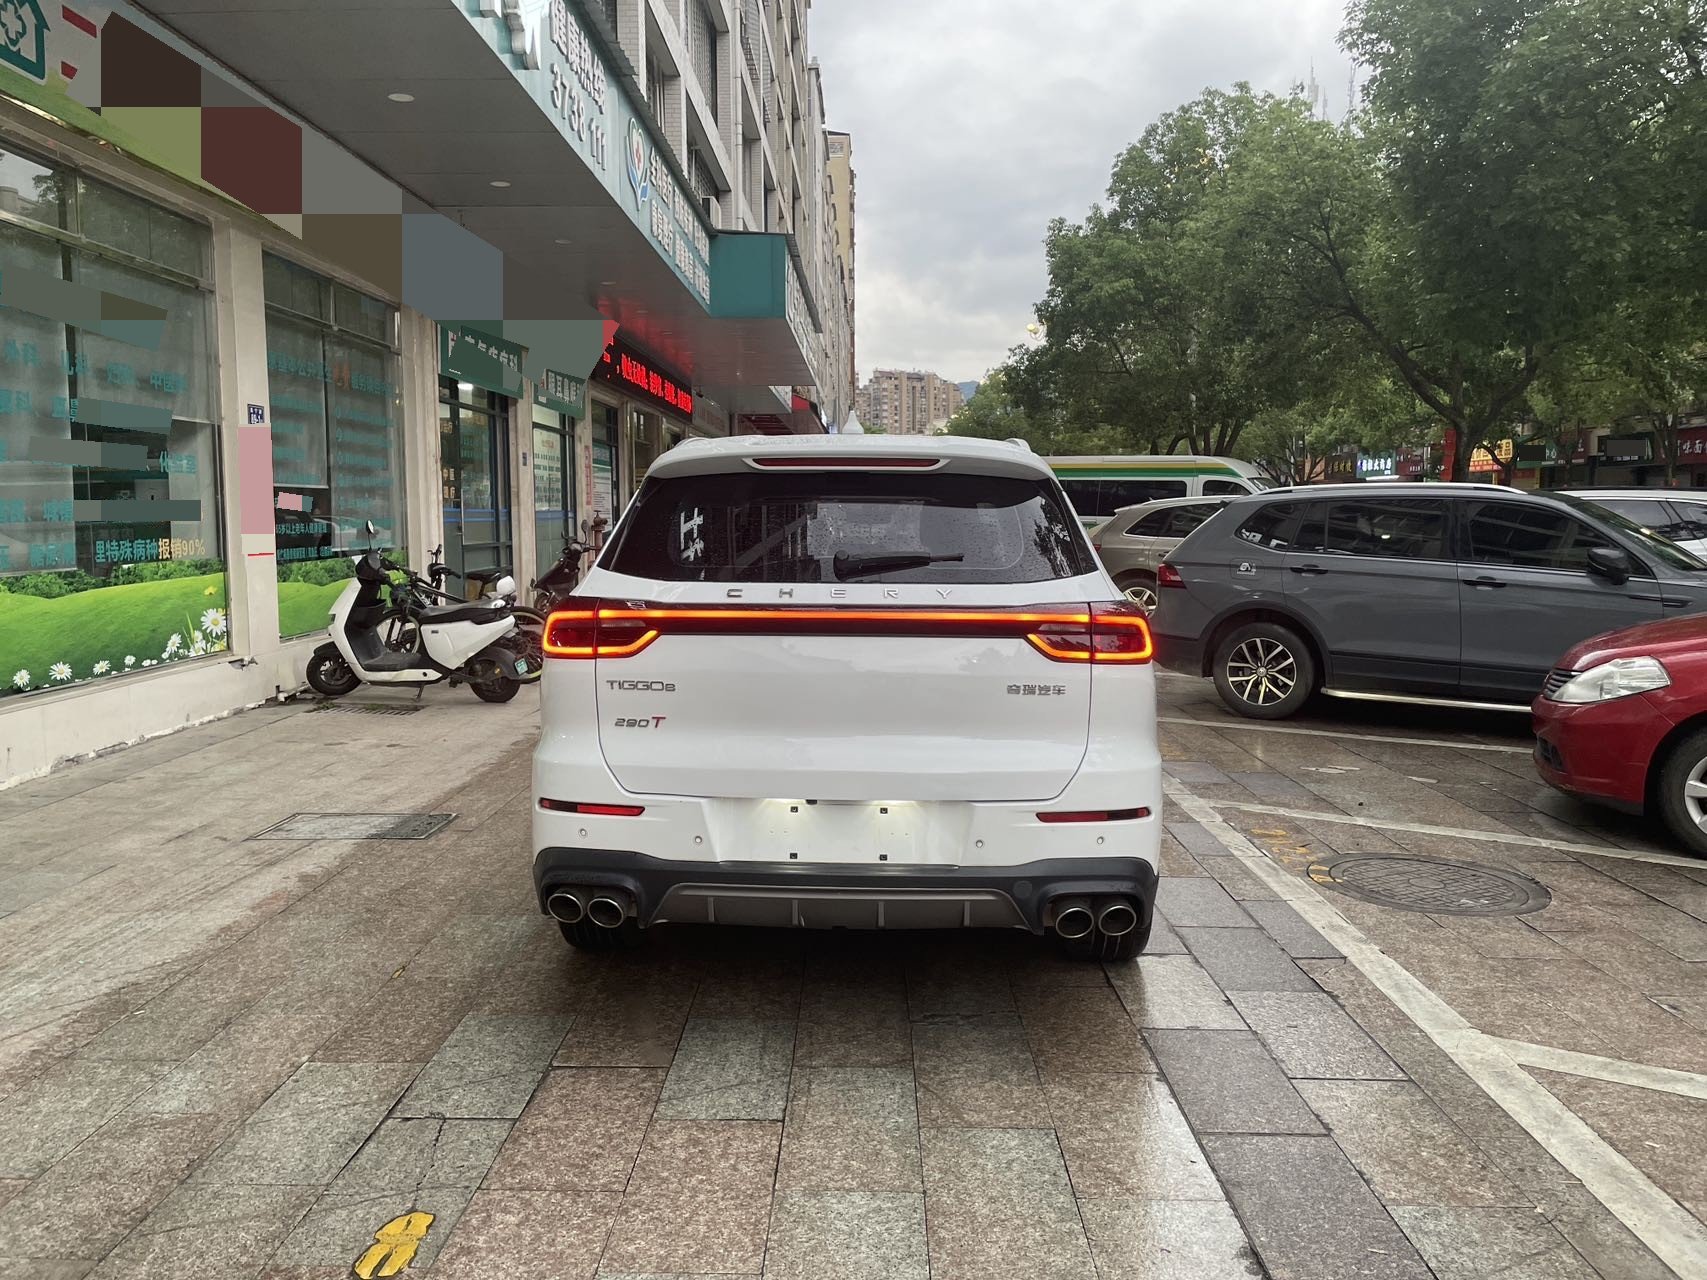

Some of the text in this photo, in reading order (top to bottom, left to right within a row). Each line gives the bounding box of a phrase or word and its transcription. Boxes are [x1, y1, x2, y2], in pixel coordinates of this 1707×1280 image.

[95, 538, 206, 563] 里特殊病种报销90%
[726, 587, 953, 599] CHERY
[1007, 684, 1067, 696] 奇瑞汽车
